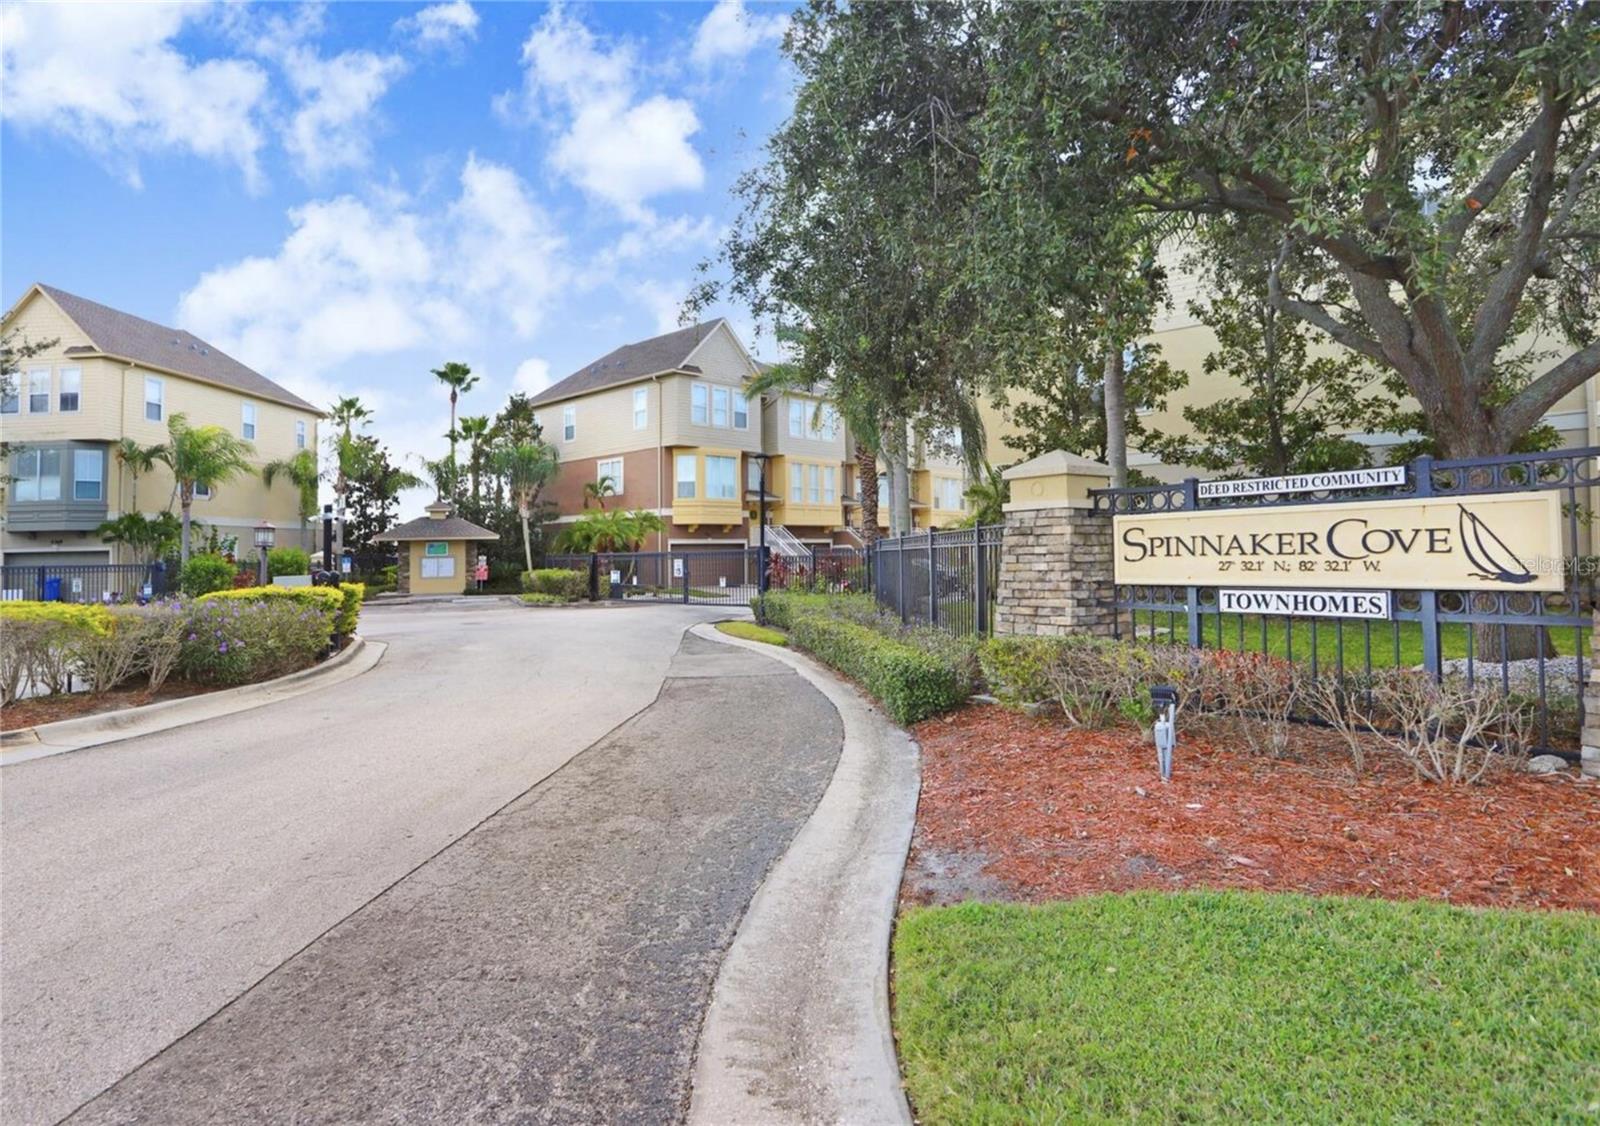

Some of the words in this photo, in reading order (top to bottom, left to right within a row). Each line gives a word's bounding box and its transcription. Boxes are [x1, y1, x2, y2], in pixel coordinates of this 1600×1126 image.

[1200, 483, 1230, 496] DEED
[1233, 477, 1309, 493] RESTRICTED
[1311, 470, 1401, 488] COMMUNITY
[1122, 527, 1322, 563] SPINNAKER
[1326, 518, 1453, 560] COVE
[1222, 592, 1383, 615] TOWNHOMES
